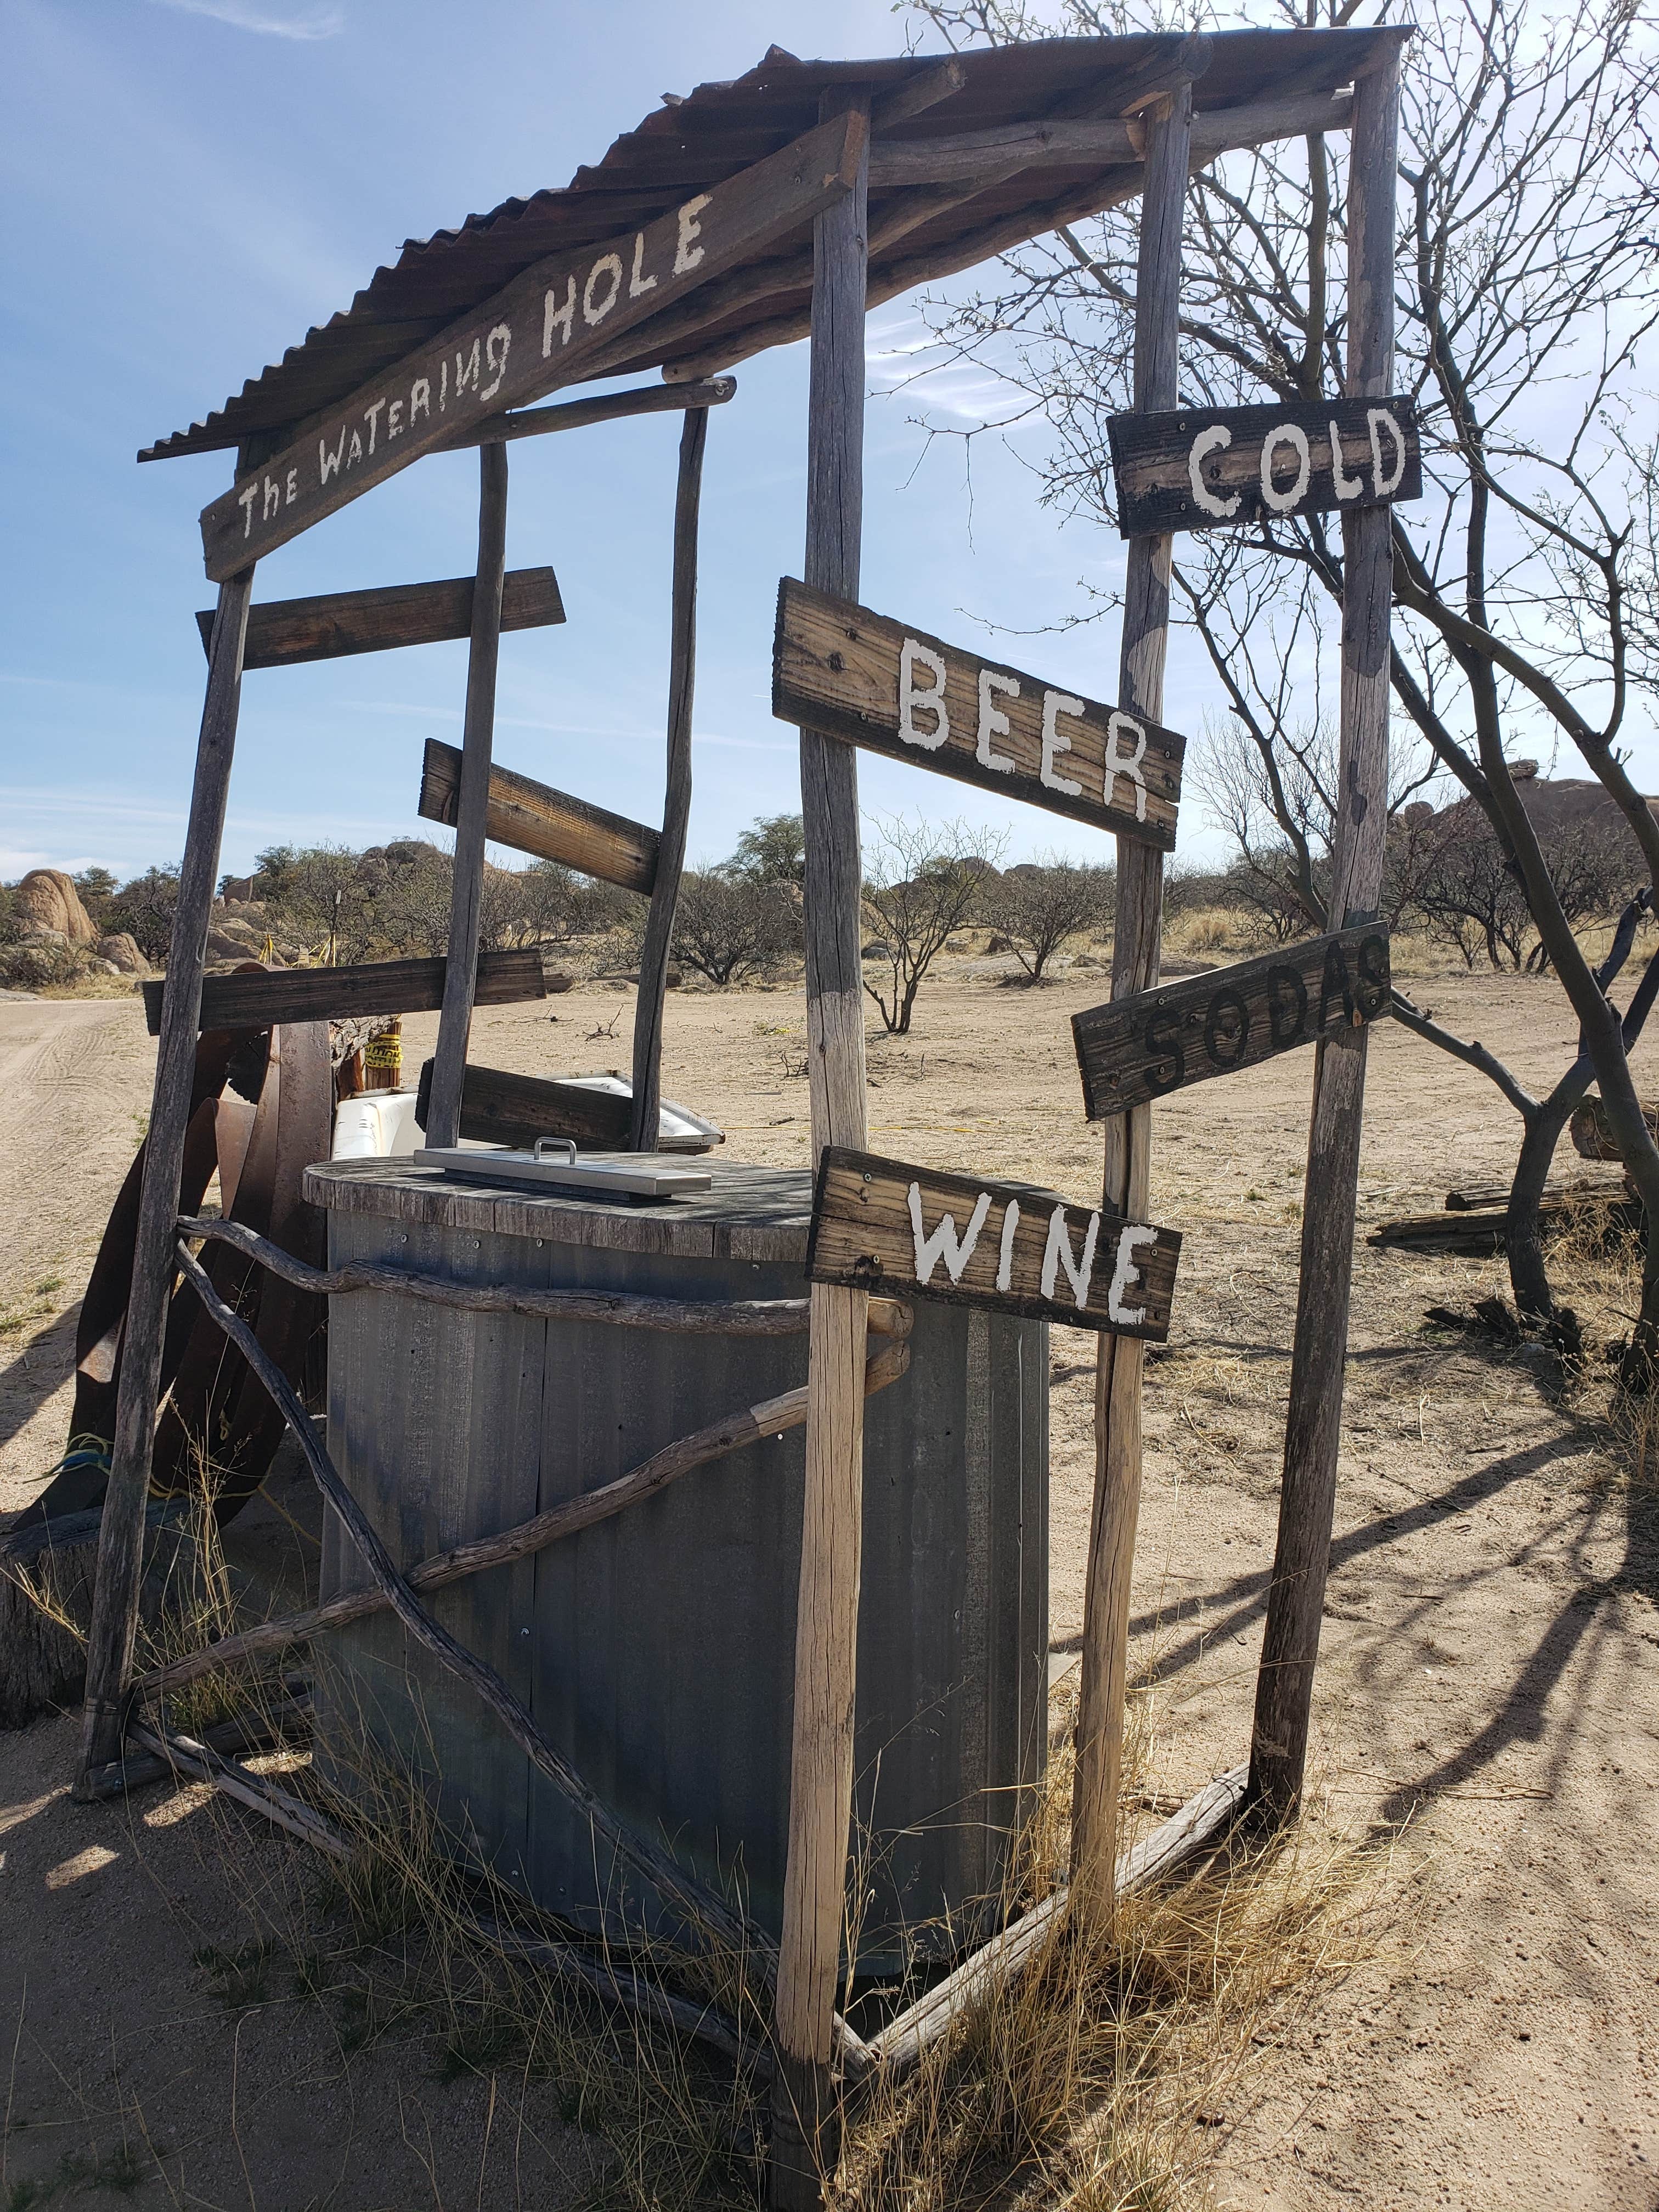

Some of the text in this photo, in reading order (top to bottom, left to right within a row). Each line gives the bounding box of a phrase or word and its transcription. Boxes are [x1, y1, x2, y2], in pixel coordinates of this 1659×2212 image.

[542, 193, 713, 358] HOLE
[1188, 408, 1406, 518] COLD
[898, 637, 1147, 823] BEER
[1144, 934, 1389, 1094] SODAS
[907, 1181, 1159, 1325] WINE
